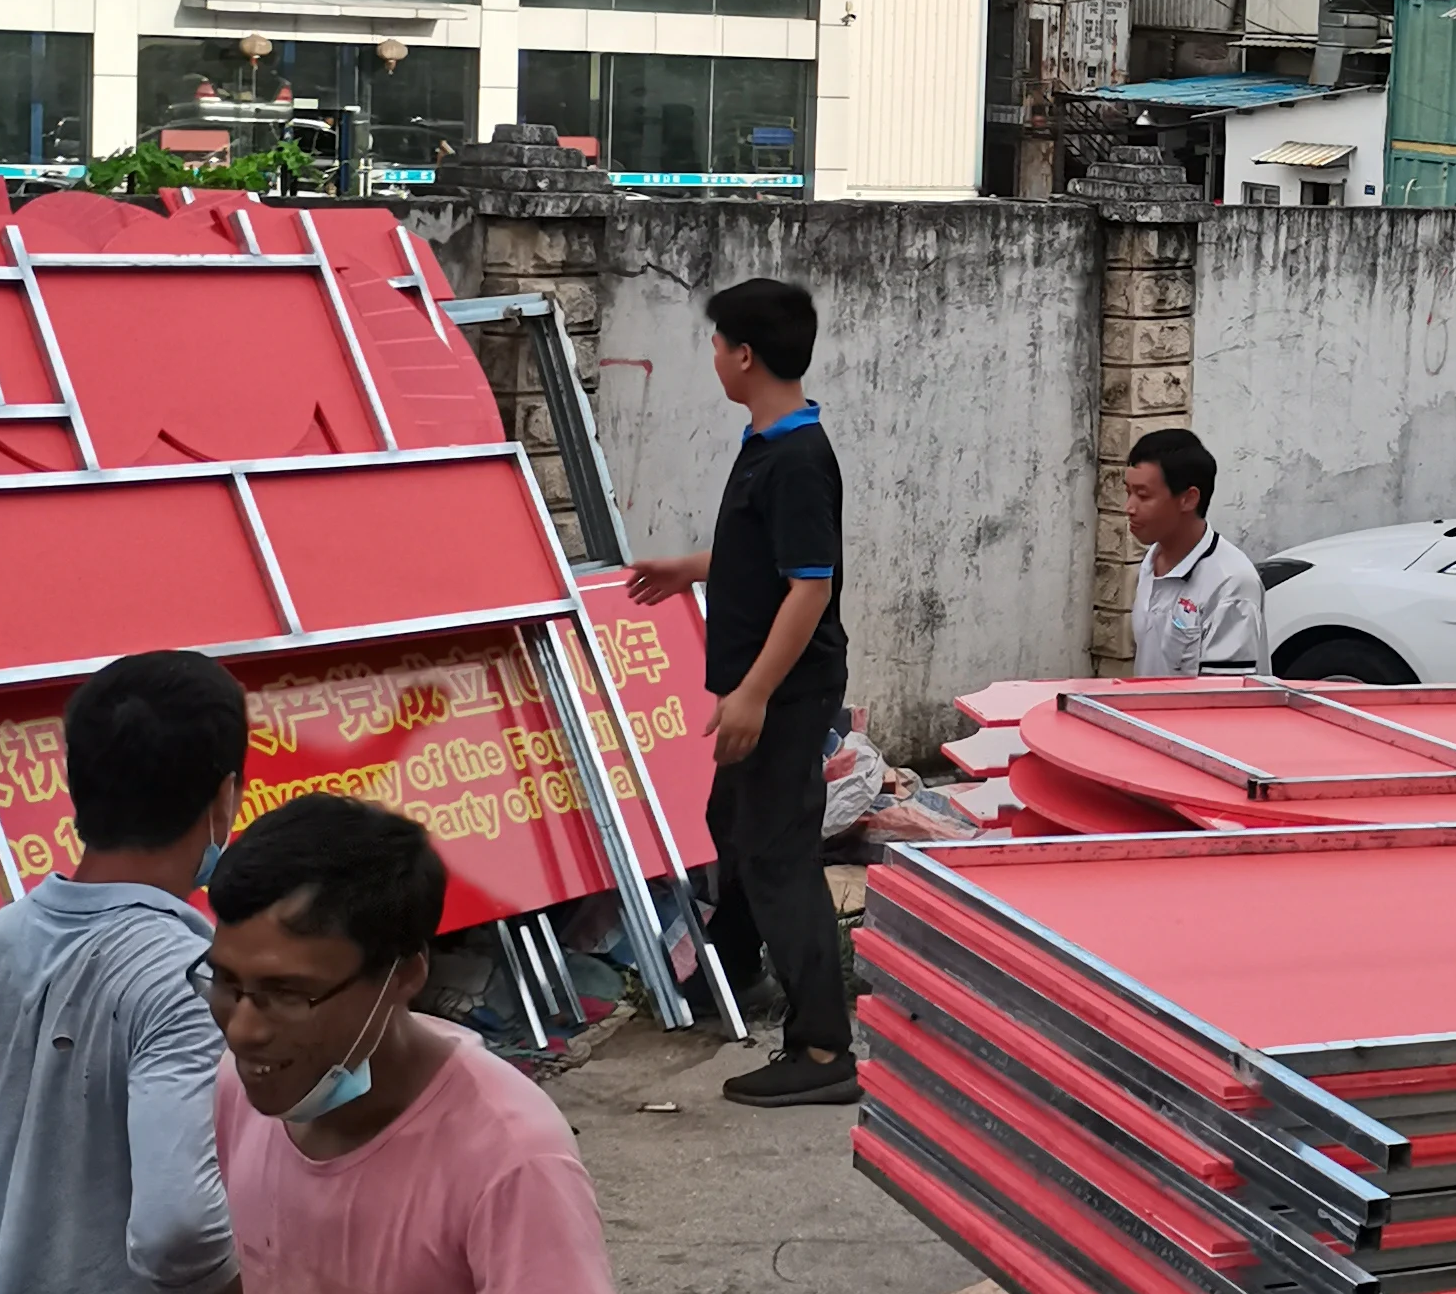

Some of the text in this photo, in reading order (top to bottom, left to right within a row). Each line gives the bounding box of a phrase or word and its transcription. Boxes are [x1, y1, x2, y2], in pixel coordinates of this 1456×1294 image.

[406, 743, 447, 791] of
[446, 737, 507, 783] the
[652, 696, 688, 739] of
[405, 791, 500, 840] Party
[503, 776, 543, 824] of
